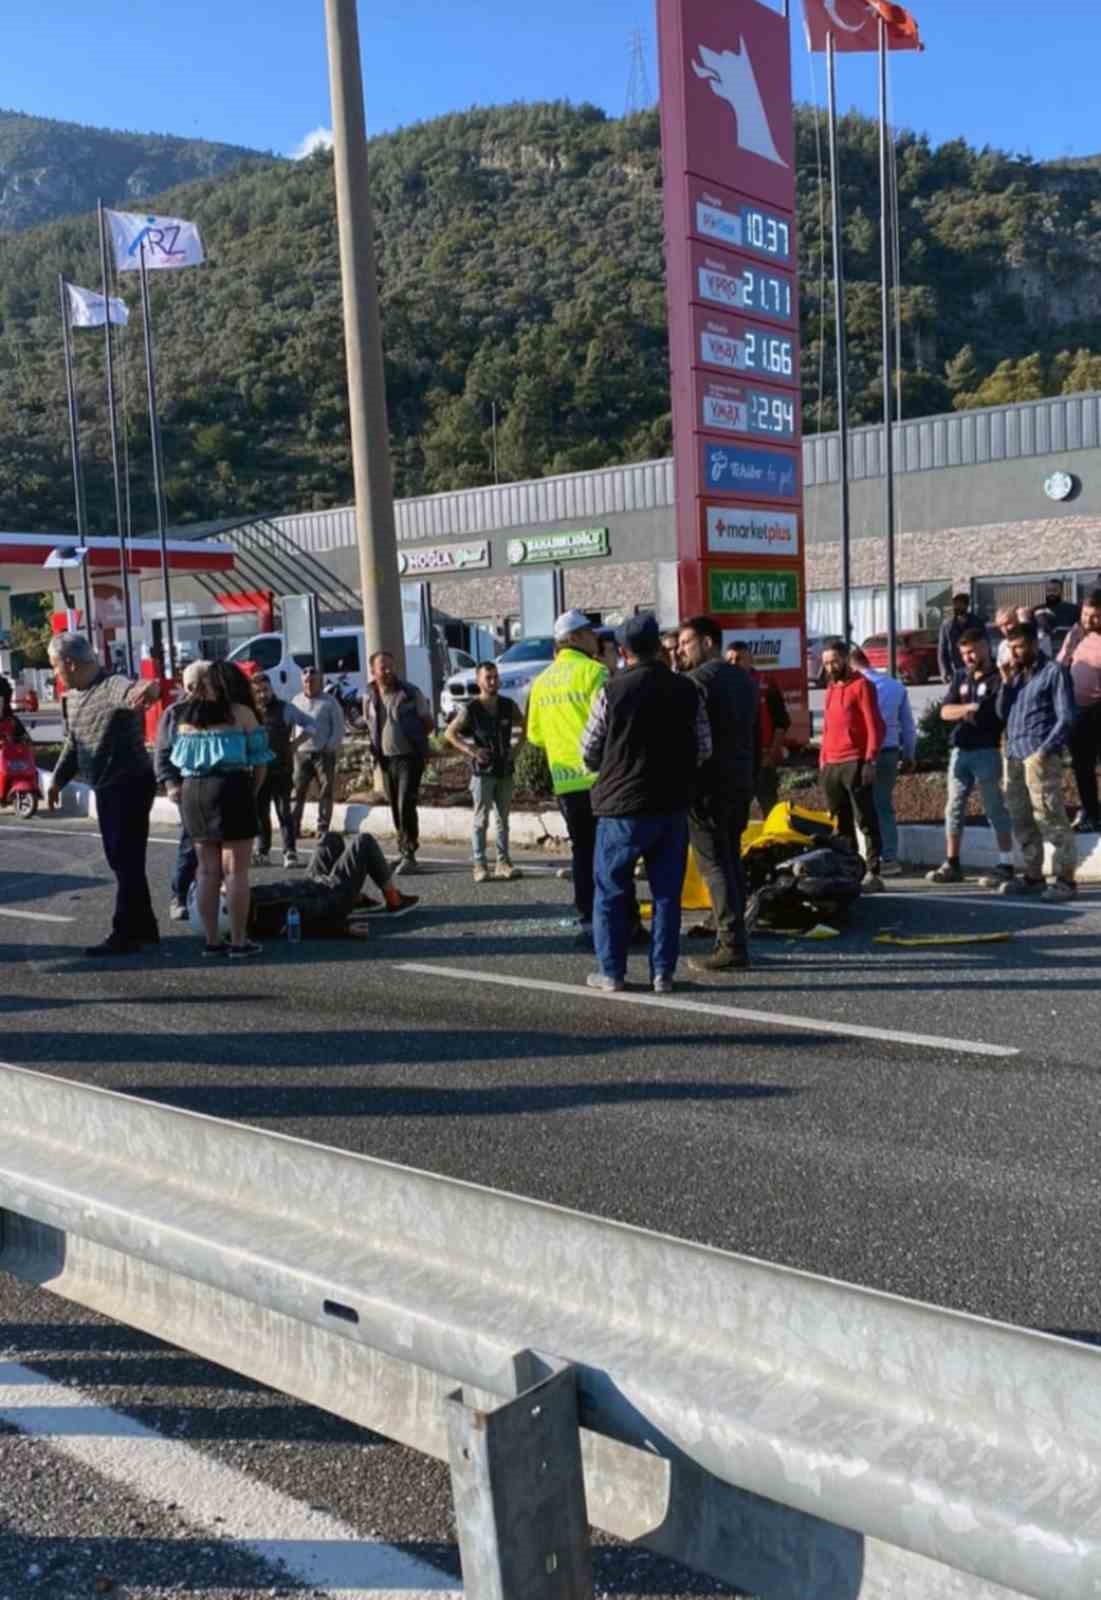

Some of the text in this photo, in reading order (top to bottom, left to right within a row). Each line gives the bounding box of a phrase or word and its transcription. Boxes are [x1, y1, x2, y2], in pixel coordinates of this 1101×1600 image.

[747, 212, 789, 255] 10.37
[743, 271, 791, 315] 21.71
[744, 334, 792, 375] 21.66
